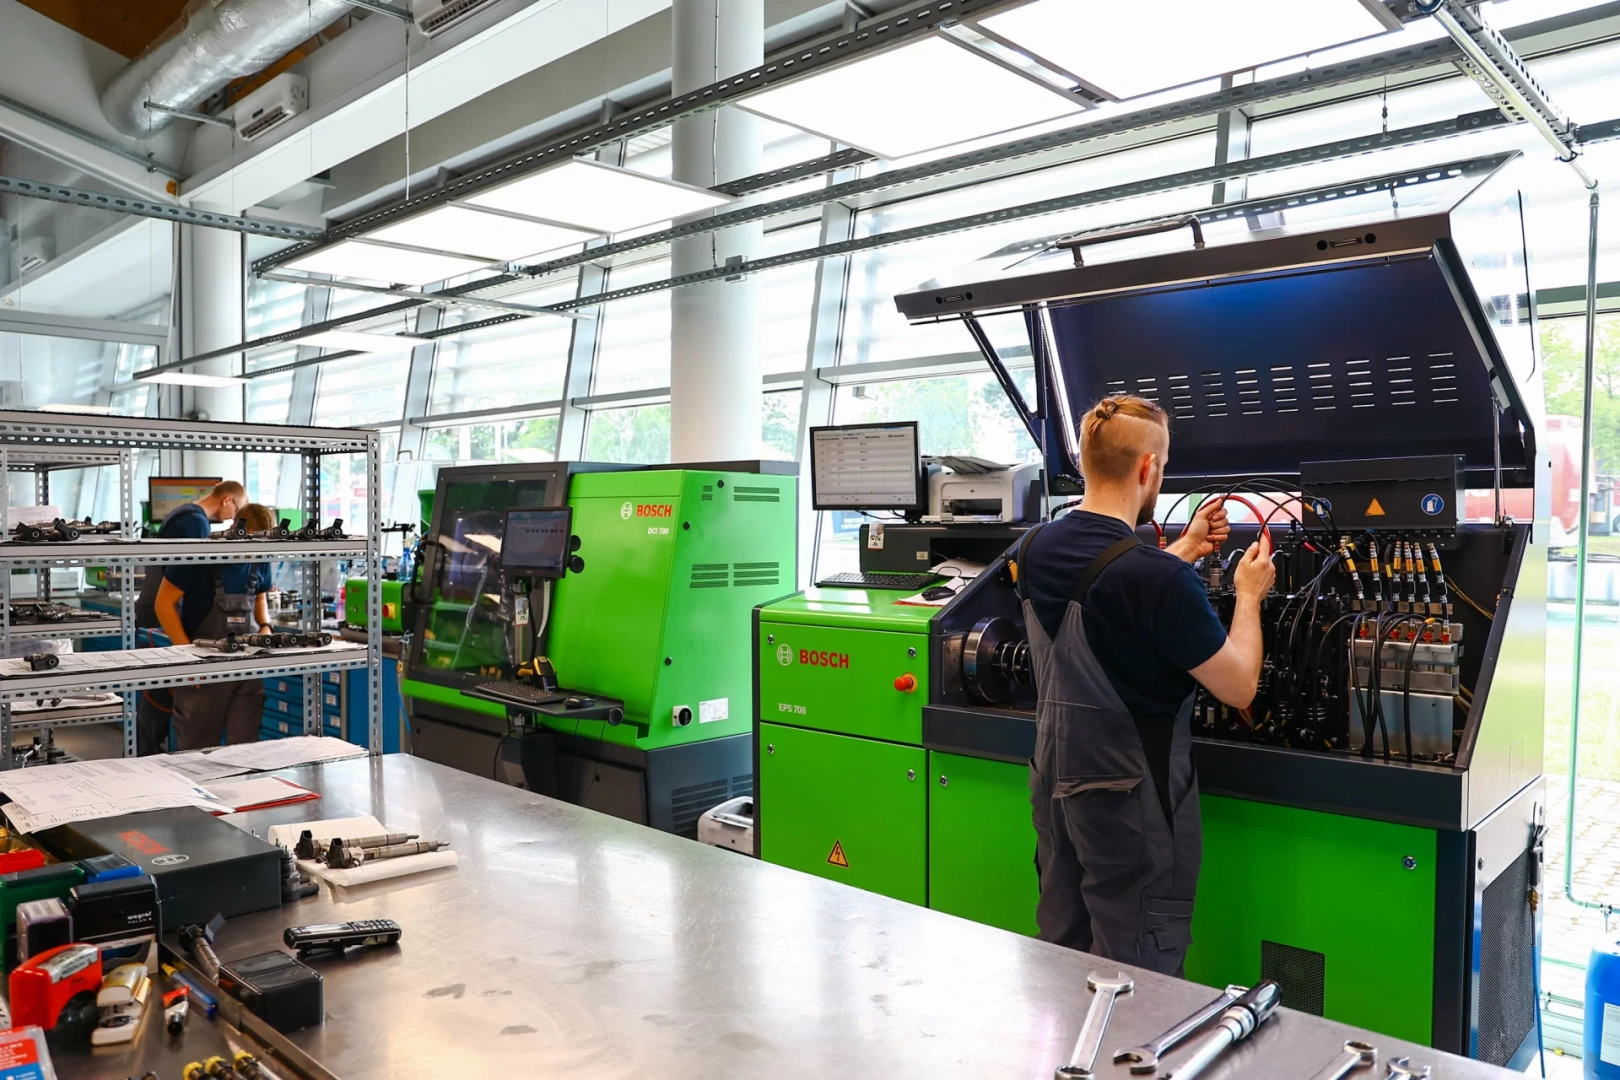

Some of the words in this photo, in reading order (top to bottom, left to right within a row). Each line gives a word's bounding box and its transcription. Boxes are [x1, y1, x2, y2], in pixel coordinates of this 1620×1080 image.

[637, 505, 672, 517] BOSCH
[800, 649, 849, 668] BOSCH
[779, 703, 792, 713] EPS
[794, 705, 806, 714] 708
